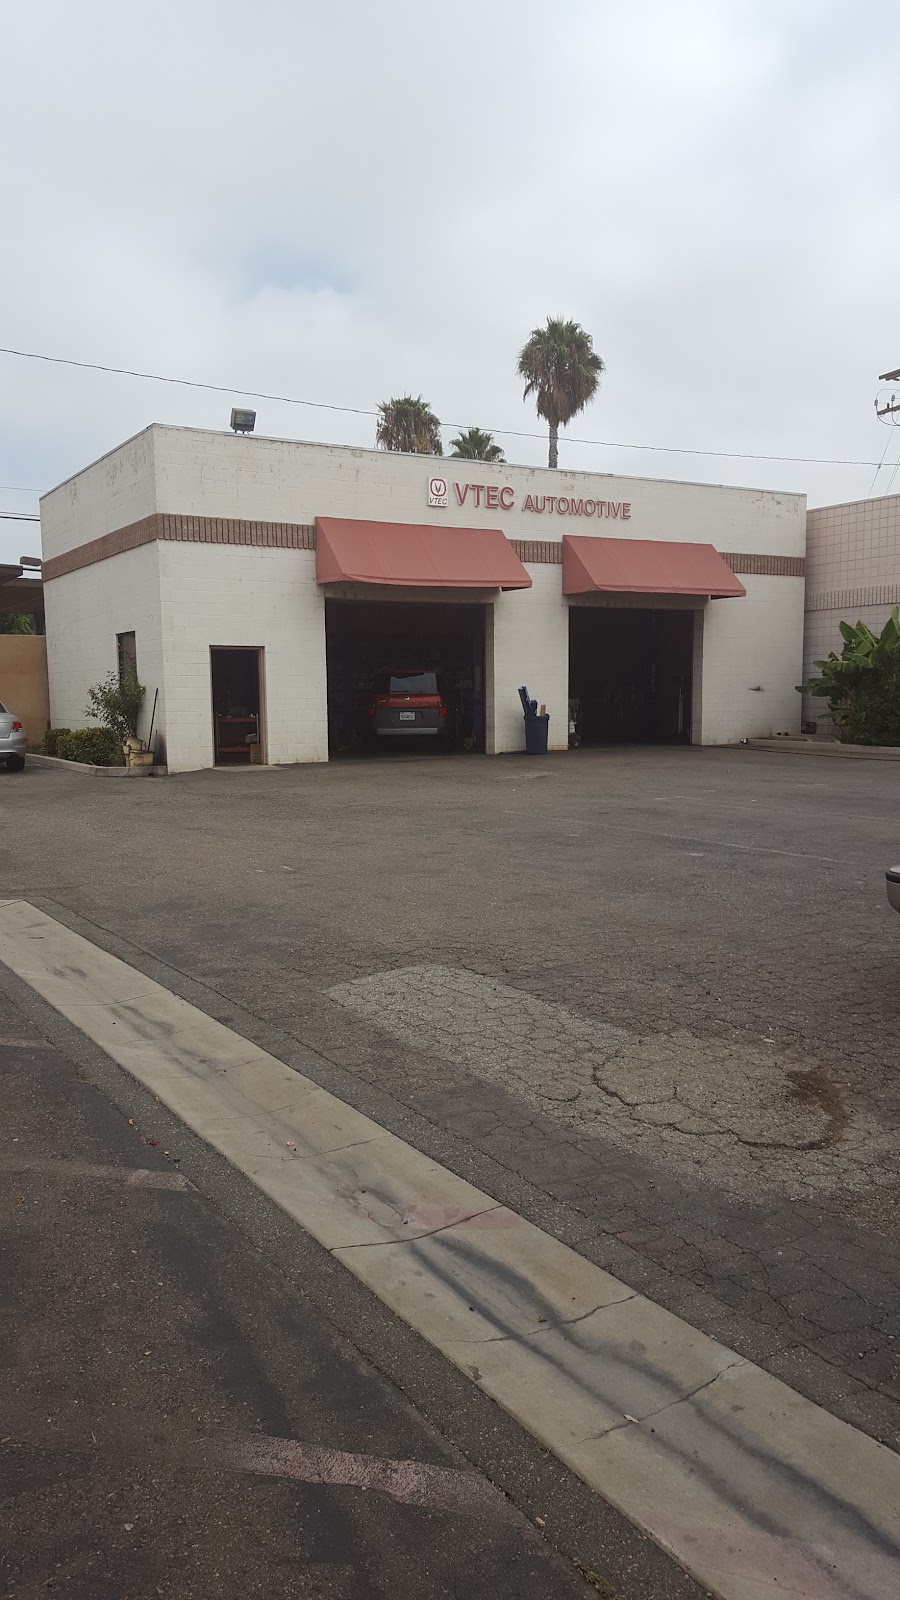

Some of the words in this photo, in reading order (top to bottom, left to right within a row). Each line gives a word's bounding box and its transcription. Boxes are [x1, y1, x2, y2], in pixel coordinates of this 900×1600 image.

[429, 497, 448, 506] VTEC
[454, 482, 515, 509] VTEC
[522, 494, 632, 520] AUTOMOTIVE
